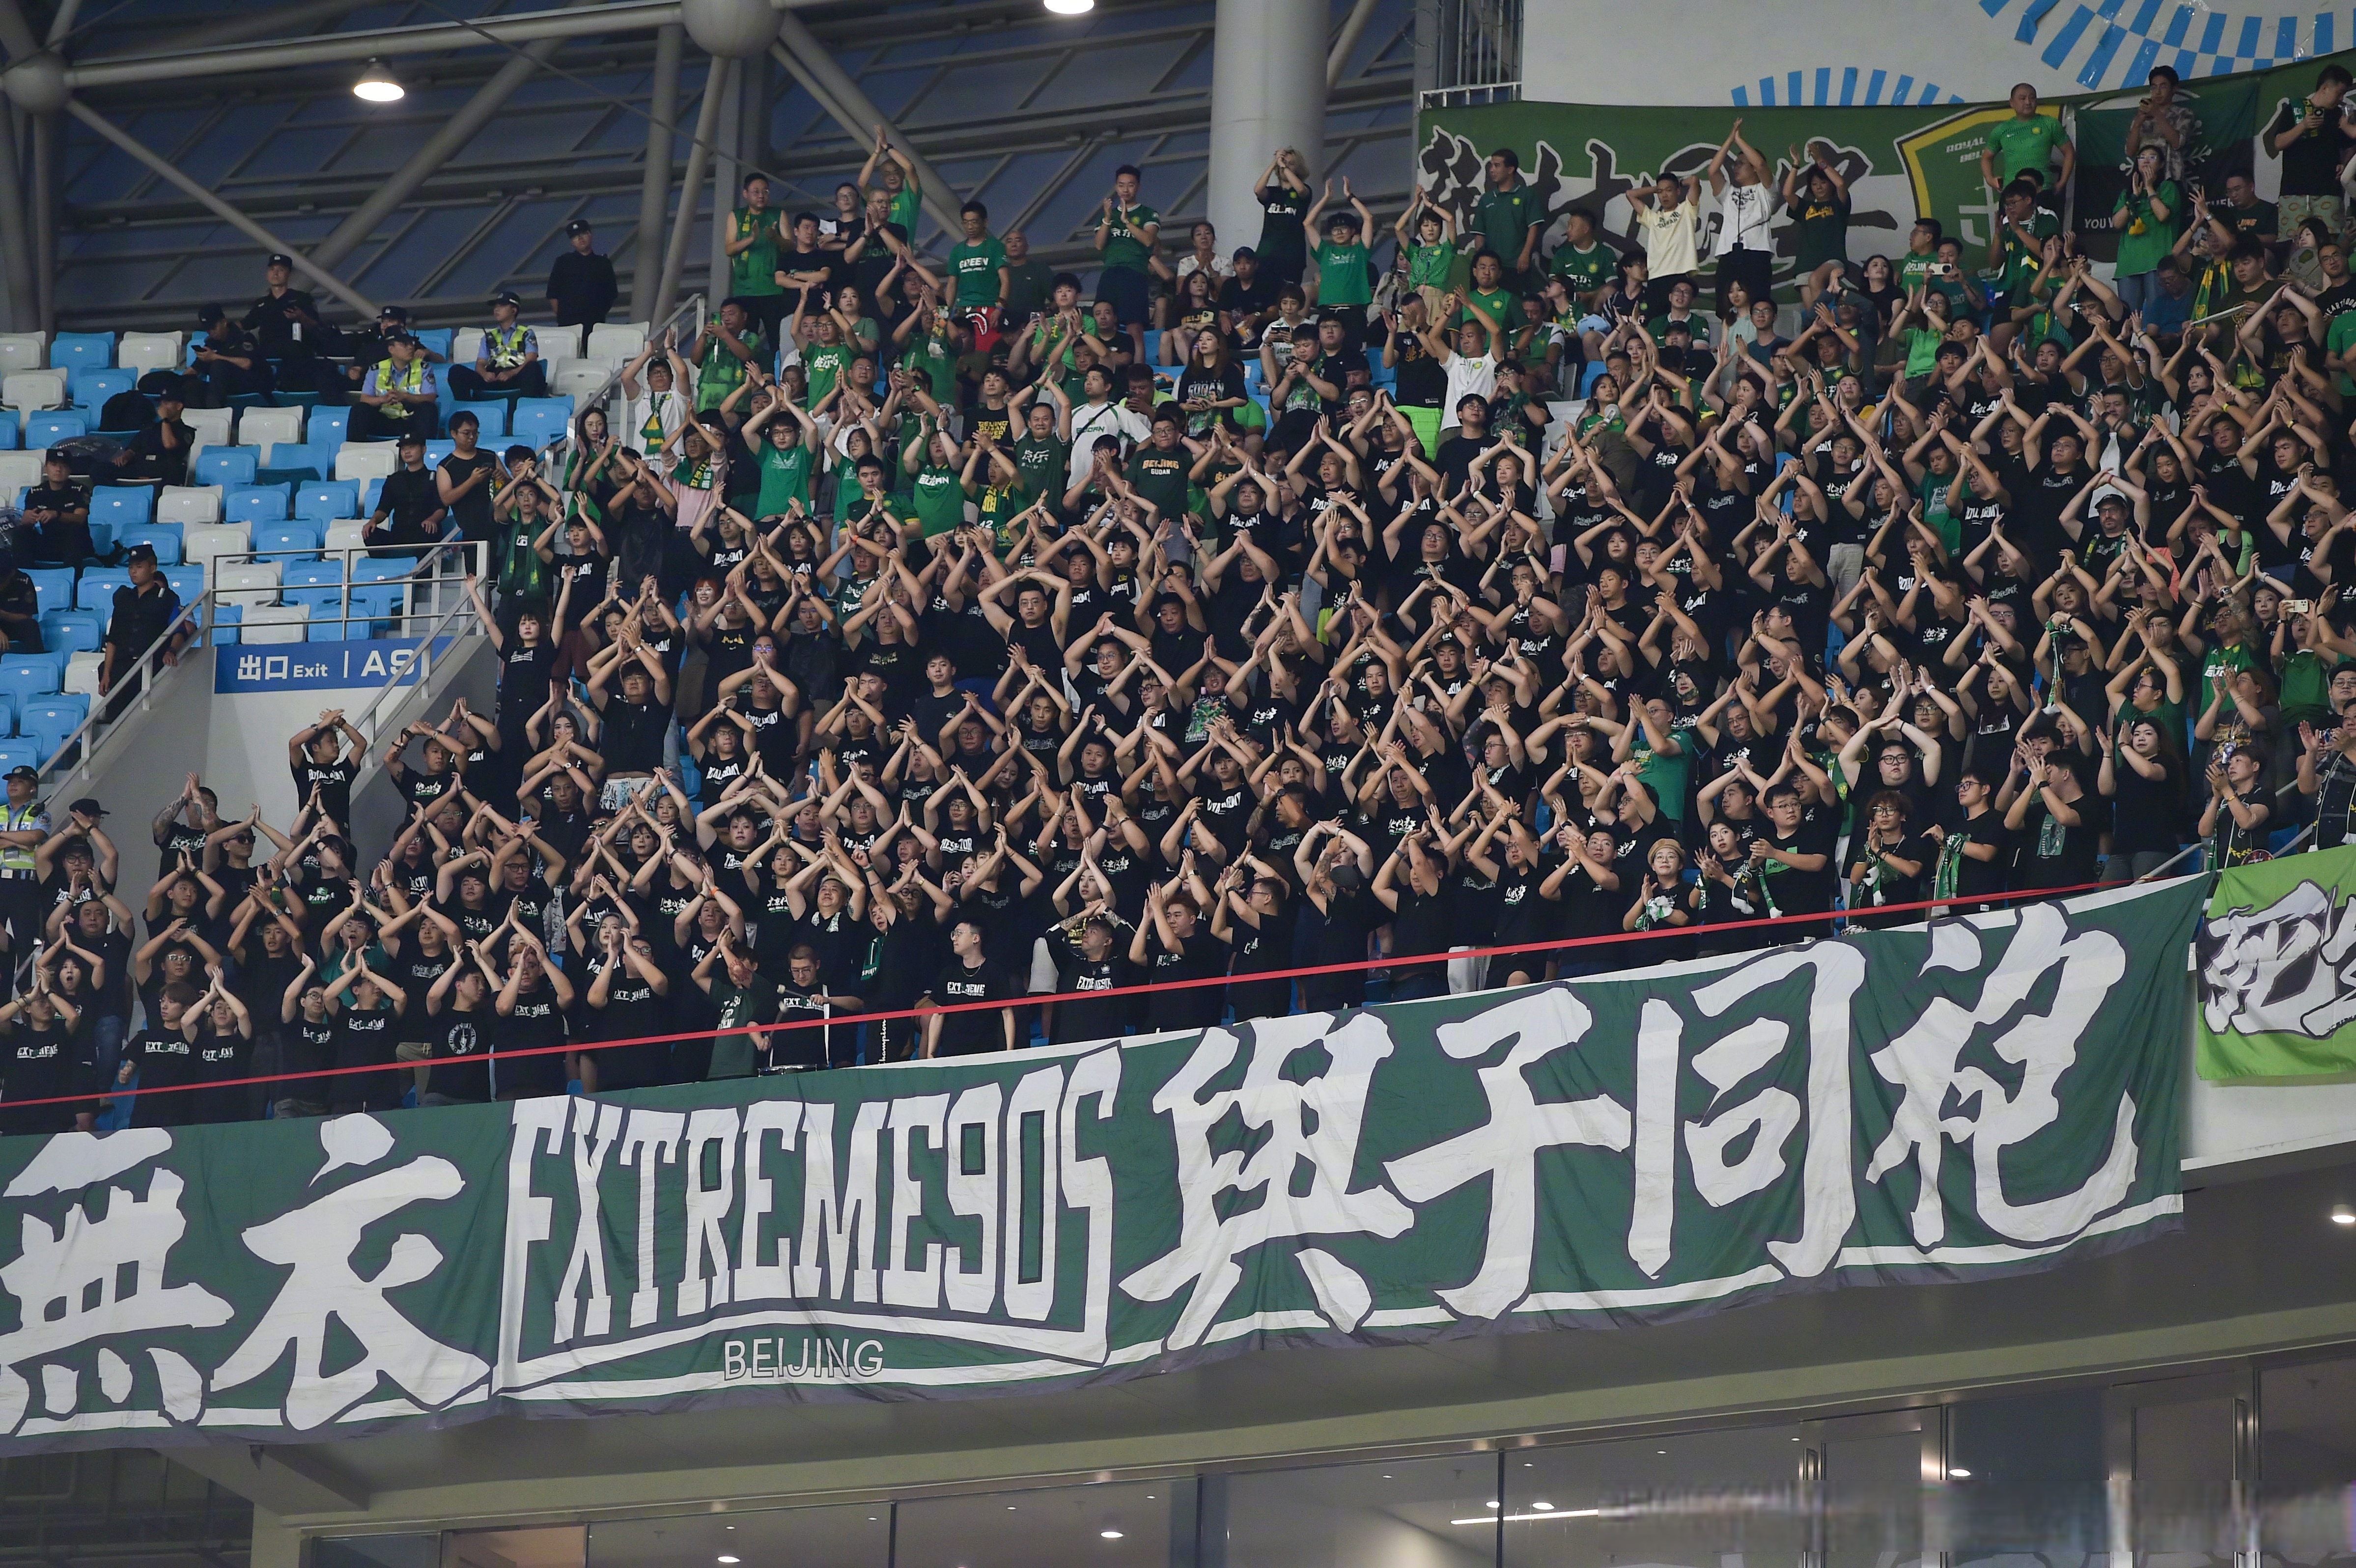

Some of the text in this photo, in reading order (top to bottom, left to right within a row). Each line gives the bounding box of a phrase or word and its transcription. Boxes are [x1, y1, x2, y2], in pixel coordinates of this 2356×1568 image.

[1946, 137, 1986, 153] ROYAL
[2084, 218, 2105, 229] YOU
[959, 257, 989, 269] GREEN
[1143, 459, 1180, 470] BEIJING
[1980, 503, 2000, 519] ARMY
[237, 654, 289, 681] 出口
[293, 662, 329, 678] Exit
[1119, 902, 2138, 1351] 與子同袍
[496, 1046, 1122, 1371] EXTREME90S
[0, 1112, 490, 1433] 無衣
[724, 1337, 884, 1381] BEIJING
